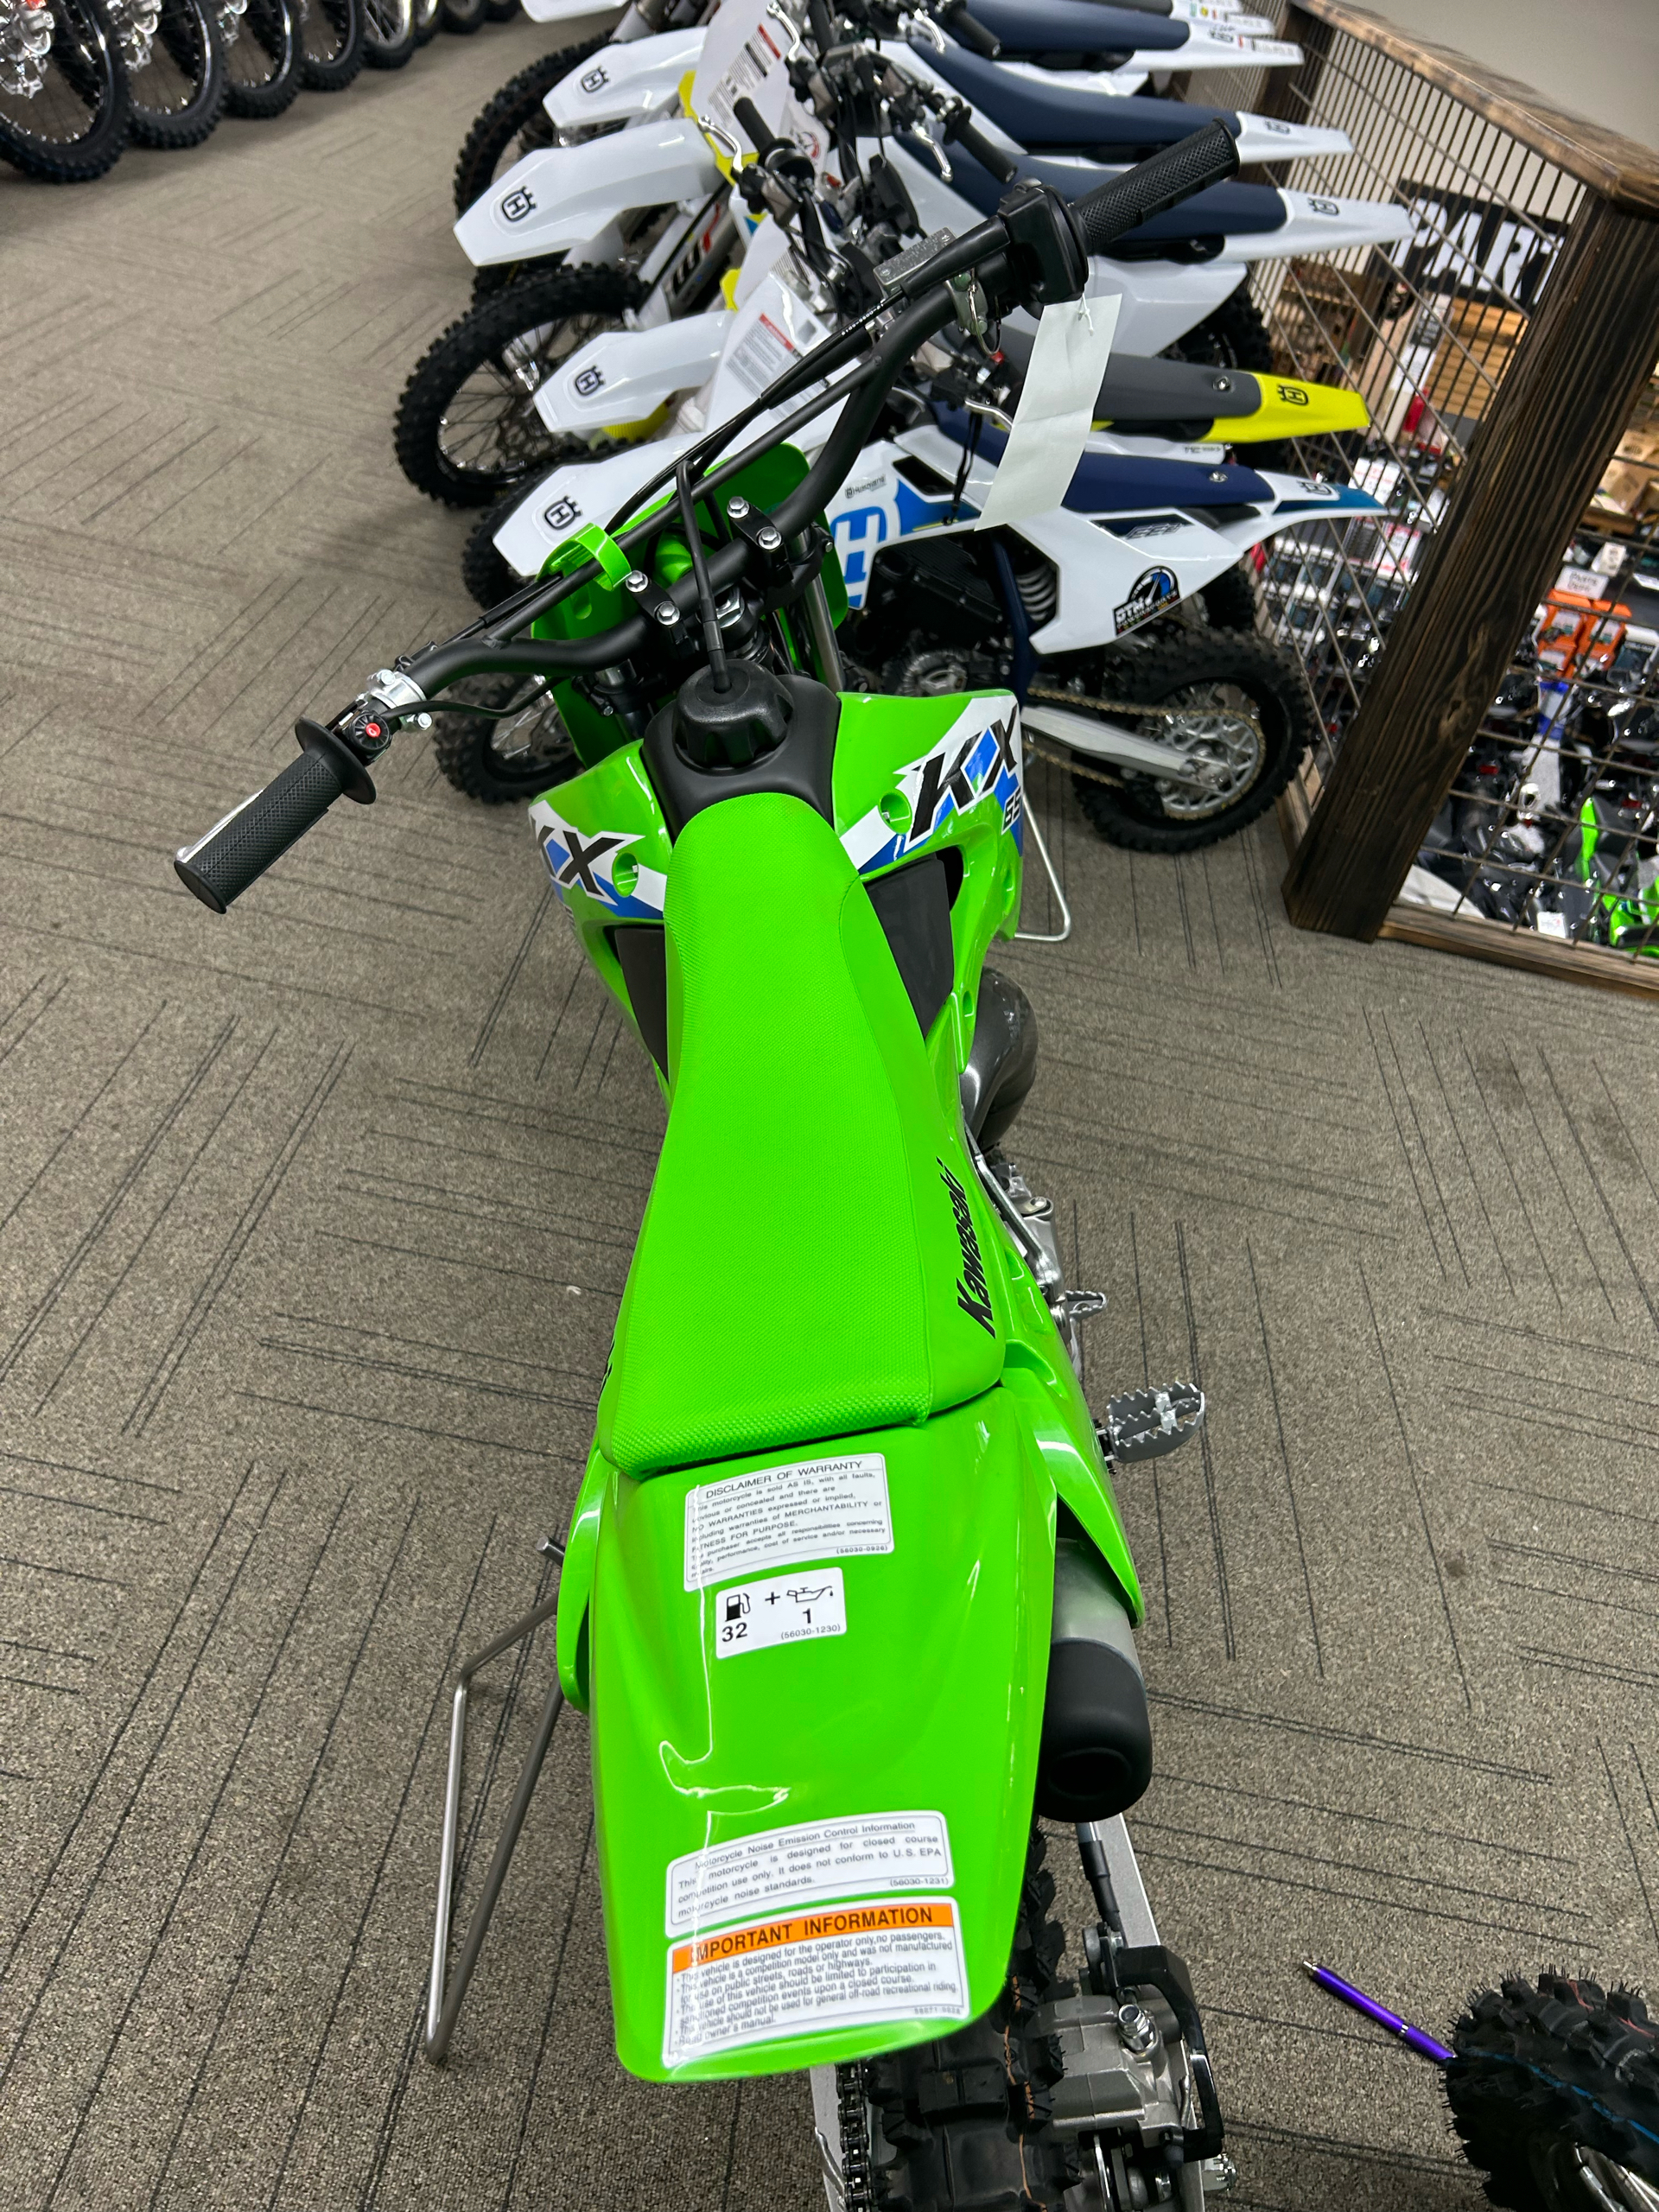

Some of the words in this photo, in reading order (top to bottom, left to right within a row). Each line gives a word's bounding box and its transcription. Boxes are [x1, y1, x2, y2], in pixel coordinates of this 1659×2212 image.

[910, 702, 1018, 843] KX
[936, 1155, 995, 1339] Kawasaki
[706, 1475, 772, 1498] DISCLAIMER
[777, 1471, 793, 1479] OF
[798, 1461, 862, 1476] WARRANTY
[709, 1508, 763, 1527] WARRANTIES
[768, 1499, 808, 1511] expressed
[712, 1492, 752, 1507] motorcycle
[728, 1517, 768, 1531] warranties
[785, 1501, 868, 1517] MERCHANTABILITY
[736, 1496, 775, 1510] concealed
[707, 1542, 740, 1556] purchaser
[747, 1535, 772, 1544] accepts
[791, 1522, 841, 1535] responsibilities
[731, 1531, 748, 1541] FOR
[753, 1520, 798, 1535] PURPOSE.
[721, 1622, 748, 1643] 32
[802, 1608, 811, 1624] 1
[780, 1624, 841, 1640] (56030-1230)
[678, 1878, 697, 1890] This
[709, 1859, 759, 1879] motorcycle
[787, 1845, 831, 1859] designed
[840, 1841, 853, 1850] for
[863, 1837, 895, 1847] closed
[695, 1850, 743, 1869] Motorcycle
[747, 1841, 773, 1854] Noise
[779, 1832, 820, 1847] Emission
[823, 1826, 858, 1839] Control
[862, 1821, 915, 1833] Information
[732, 1877, 748, 1886] use
[752, 1870, 773, 1882] only.
[779, 1866, 785, 1875] It
[789, 1860, 811, 1872] does
[816, 1859, 830, 1867] not
[836, 1853, 874, 1865] conform
[919, 1847, 942, 1856] EPA
[734, 1886, 760, 1900] noise
[765, 1875, 815, 1892] standards.
[804, 1907, 932, 1936] INFORMATION
[700, 1974, 726, 1987] vehicle
[729, 1971, 735, 1980] is
[746, 1958, 791, 1975] competition
[795, 1953, 819, 1965] model
[822, 1950, 839, 1961] only
[842, 1947, 857, 1957] and
[860, 1946, 876, 1955] was
[880, 1943, 893, 1953] not
[895, 1942, 952, 1952] manufactured
[702, 1961, 730, 1977] vehicle
[742, 1949, 781, 1966] designed
[785, 1948, 796, 1956] for
[798, 1944, 812, 1953] the
[816, 1938, 852, 1951] operator
[891, 1932, 944, 1942] passengers.
[699, 1999, 714, 2009] use
[716, 1993, 725, 2004] of
[728, 1991, 742, 2001] this
[746, 1983, 776, 1997] vehicle
[779, 1977, 808, 1989] should
[811, 1974, 823, 1983] be
[825, 1969, 855, 1981] limited
[870, 1962, 925, 1976] participation
[928, 1961, 936, 1970] in
[712, 1986, 722, 1995] on
[725, 1979, 750, 1994] public
[788, 1965, 813, 1977] roads
[828, 1958, 872, 1970] highways.
[728, 1993, 779, 2012] competition
[782, 1986, 811, 1999] events
[814, 1983, 836, 1994] upon
[840, 1981, 845, 1990] a
[849, 1974, 877, 1988] closed
[881, 1974, 914, 1984] course.
[727, 2010, 752, 2023] should
[754, 2005, 766, 2016] not
[769, 2002, 778, 2012] be
[781, 1998, 800, 2011] used
[804, 1997, 812, 2005] for
[816, 1992, 846, 2006] general
[883, 1983, 931, 1995] recreational
[741, 2016, 776, 2030] manual.
